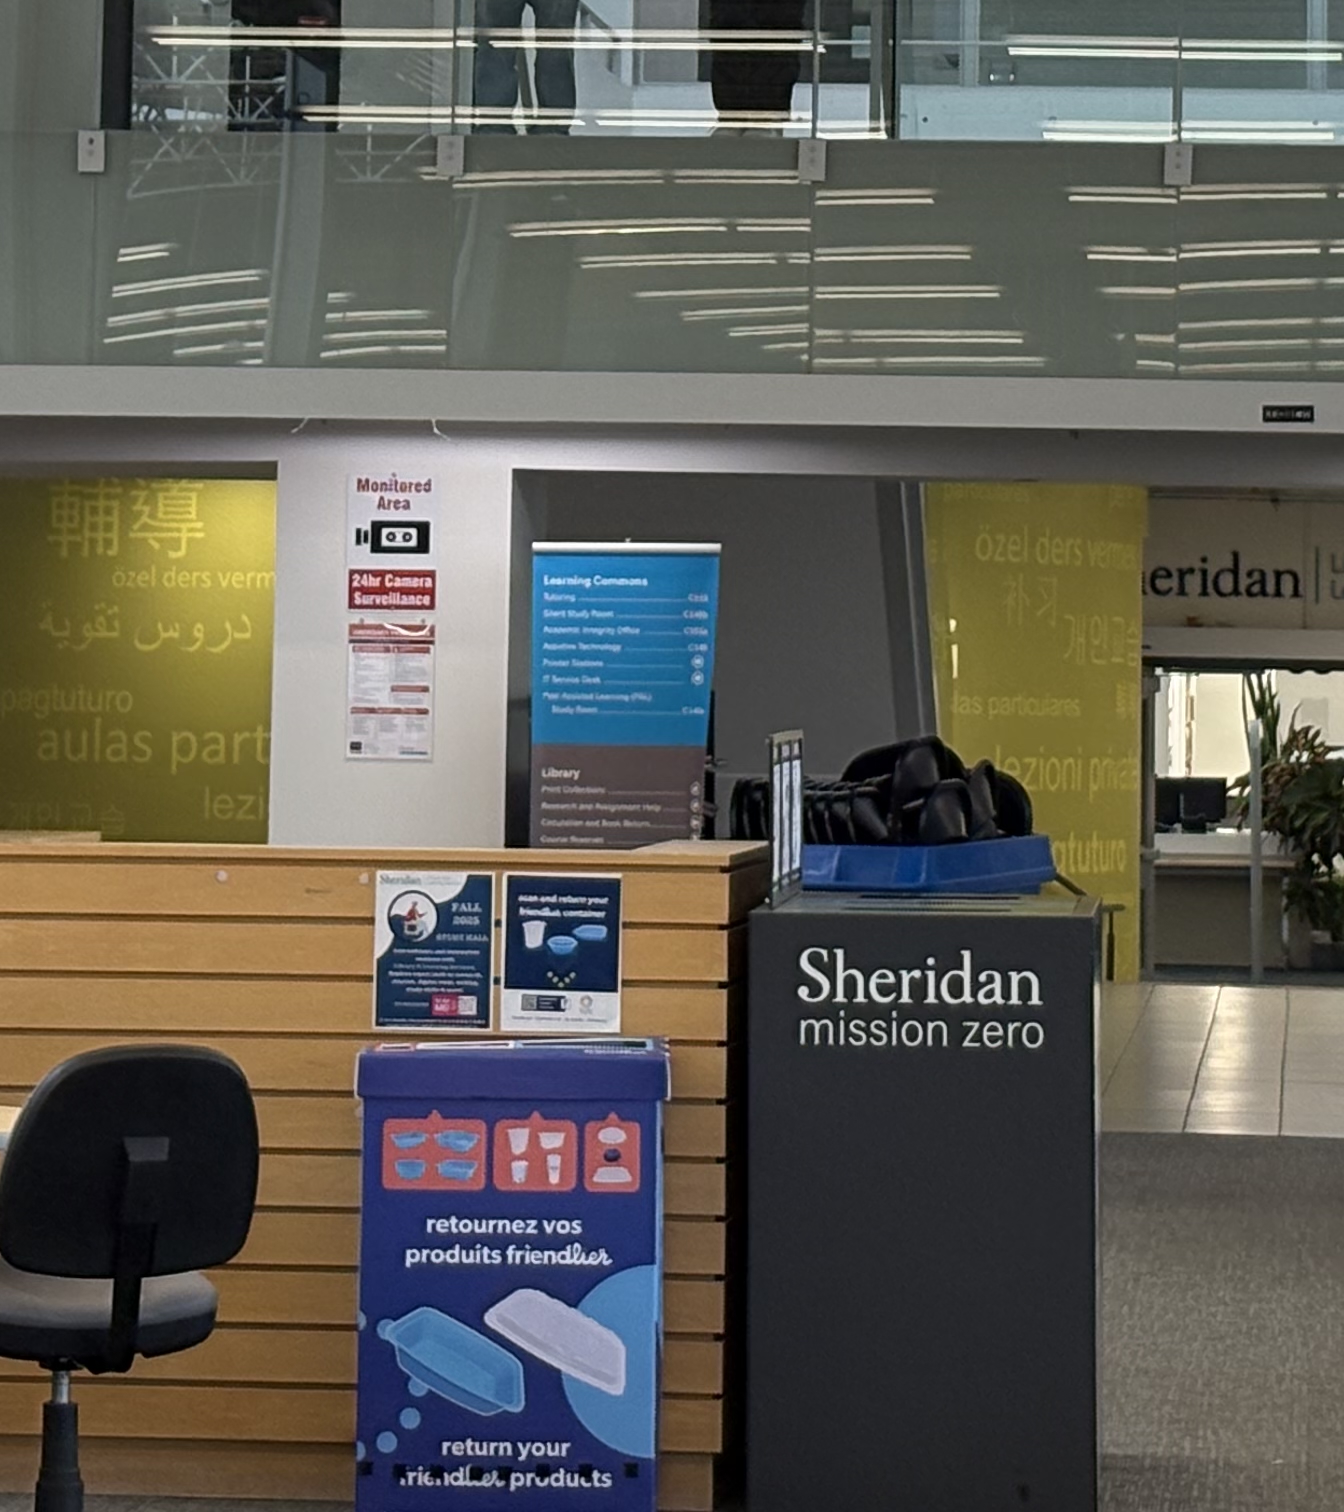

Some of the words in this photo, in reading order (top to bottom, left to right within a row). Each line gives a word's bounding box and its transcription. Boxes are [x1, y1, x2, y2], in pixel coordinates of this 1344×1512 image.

[356, 477, 432, 493] Monitored
[377, 495, 411, 510] Area
[975, 525, 1028, 563] özel
[1035, 527, 1083, 566] ders
[111, 565, 155, 589] özel
[162, 565, 212, 589] ders
[351, 573, 382, 588] 24hr
[384, 573, 433, 588] Camera
[543, 574, 592, 588] Learning
[593, 574, 648, 587] Commons
[1143, 550, 1304, 600] eridan
[353, 591, 431, 606] Surveillance
[37, 716, 154, 763] aulas
[541, 767, 581, 780] Library
[205, 786, 265, 821] lezi
[1052, 831, 1128, 874] gtuturo
[451, 902, 482, 913] FALL
[452, 915, 481, 926] 2025
[796, 946, 1044, 1006] Sheridan
[799, 1010, 948, 1046] mission
[962, 1020, 1045, 1049] zero
[426, 1215, 538, 1235] retournez
[542, 1219, 583, 1235] vos
[405, 1244, 502, 1267] produits
[505, 1242, 613, 1266] friendlier
[441, 1438, 513, 1457] return
[517, 1441, 571, 1462] your
[399, 1464, 506, 1487] riendler
